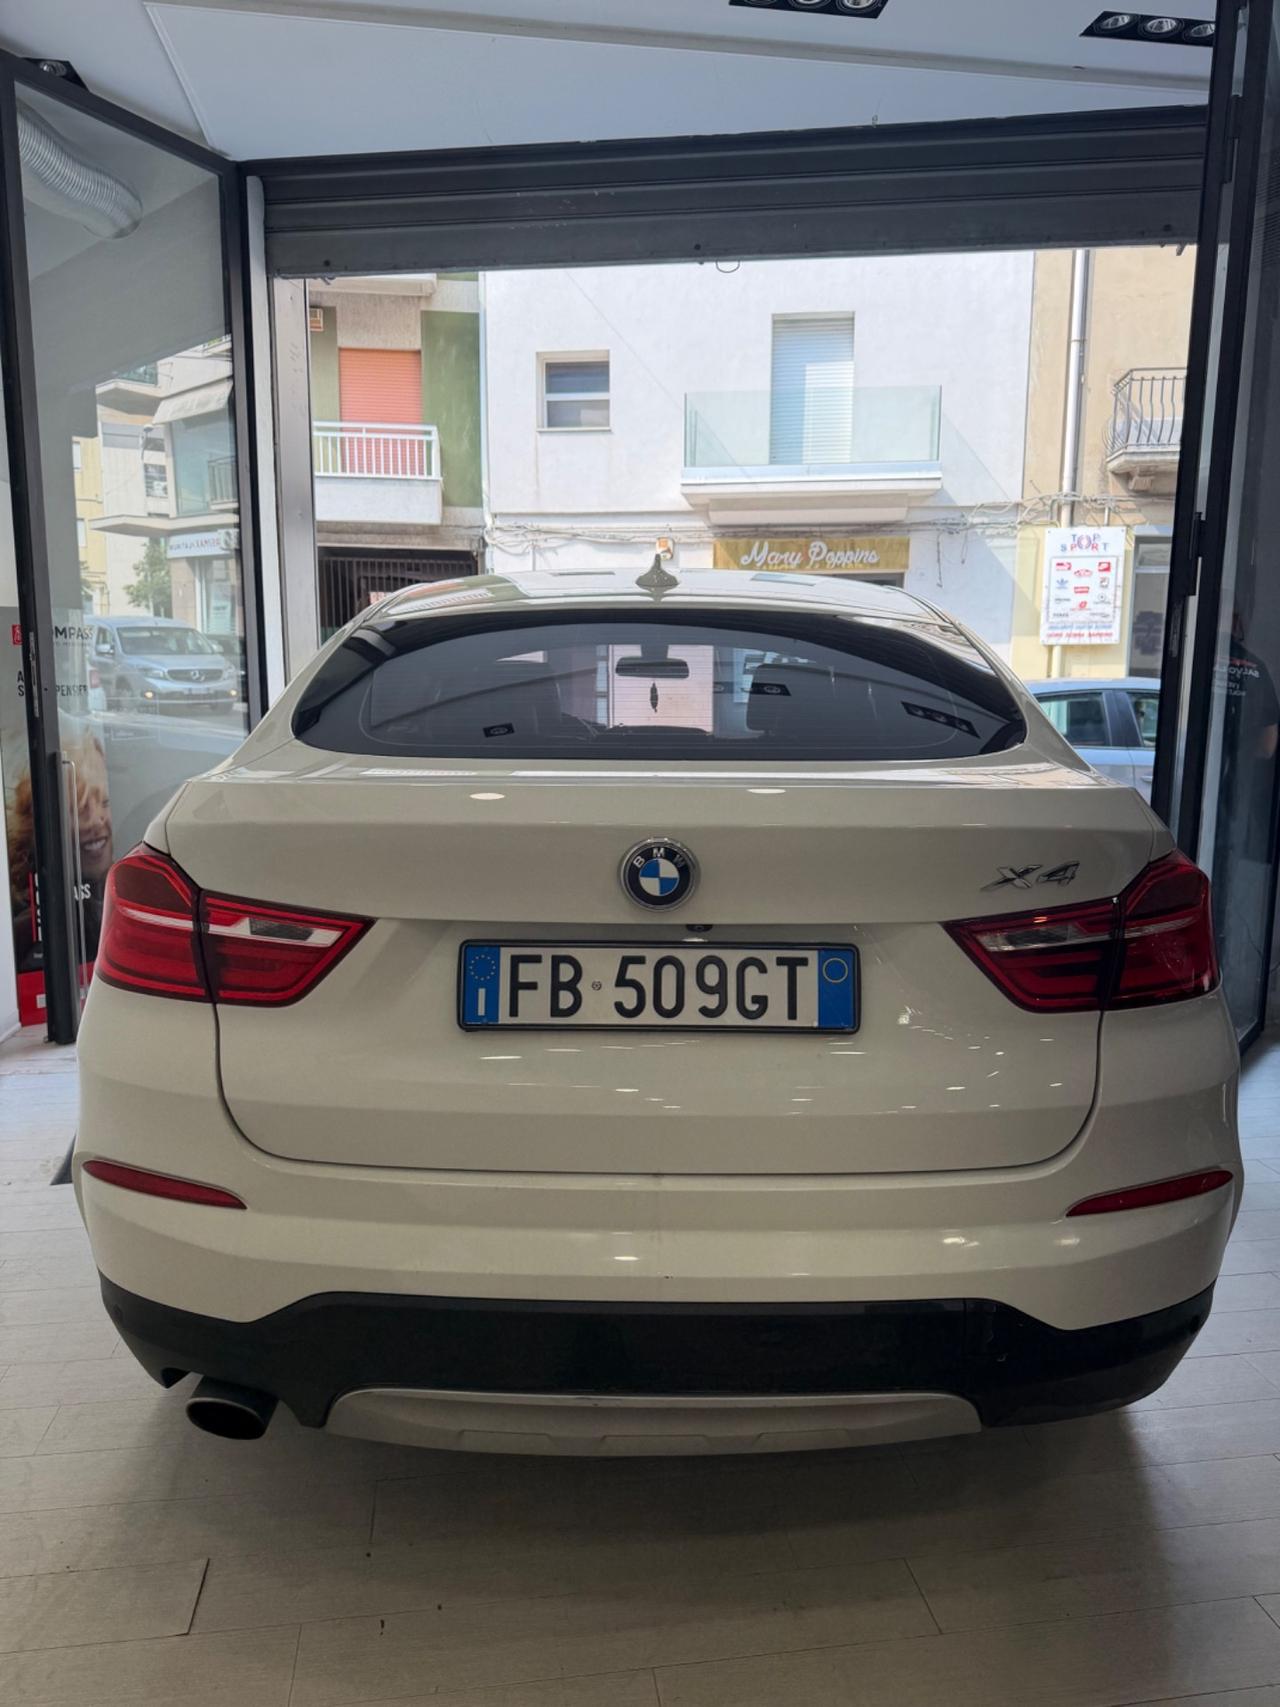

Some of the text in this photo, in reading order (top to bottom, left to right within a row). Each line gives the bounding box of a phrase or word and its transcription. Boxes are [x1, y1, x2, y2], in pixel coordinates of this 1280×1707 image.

[740, 540, 880, 568] Mary Poppins
[53, 626, 93, 640] MPASS
[633, 847, 686, 868] BMW
[980, 861, 1080, 890] X4
[509, 954, 583, 1018] FB
[614, 955, 809, 1020] 509GT
